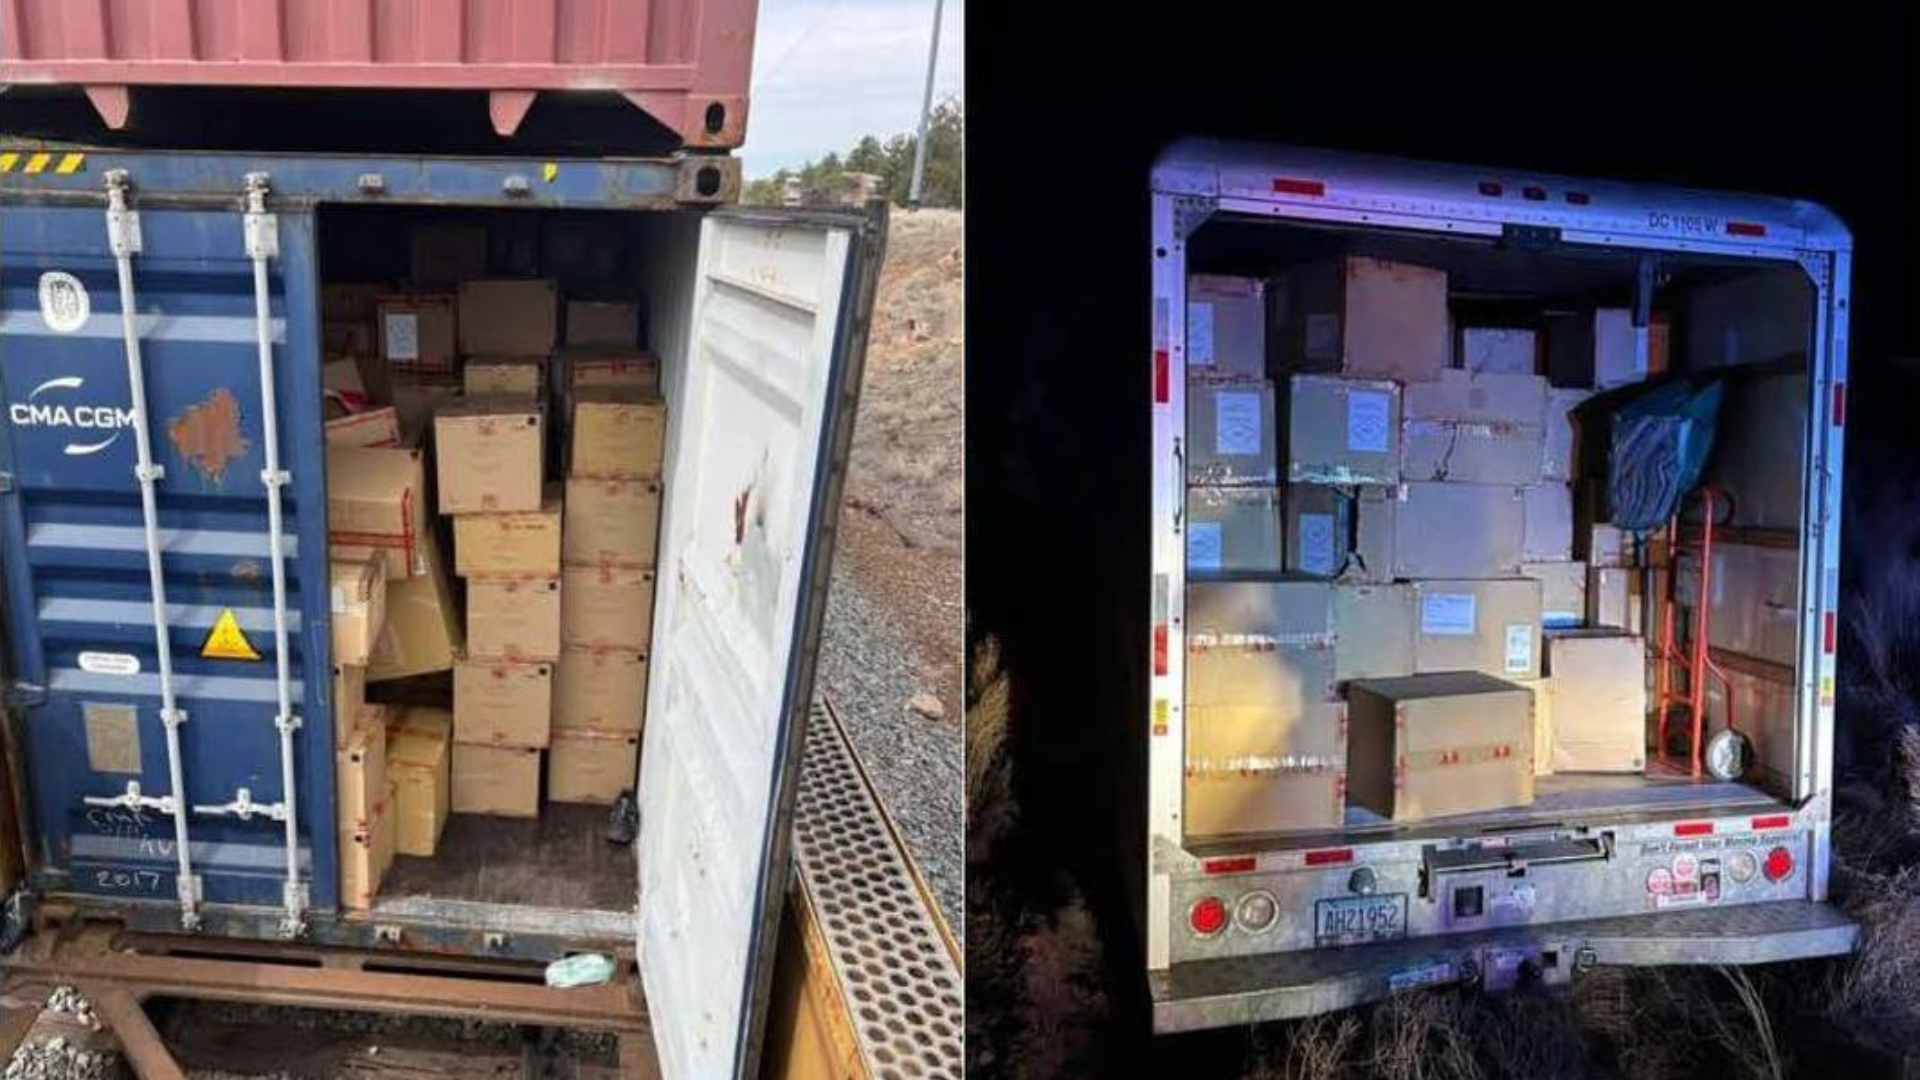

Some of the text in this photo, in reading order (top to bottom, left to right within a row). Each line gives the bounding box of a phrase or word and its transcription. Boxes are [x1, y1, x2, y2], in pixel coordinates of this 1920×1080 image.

[1647, 212, 1670, 229] DC
[10, 403, 137, 429] CMA CGM
[96, 869, 160, 891] 2017
